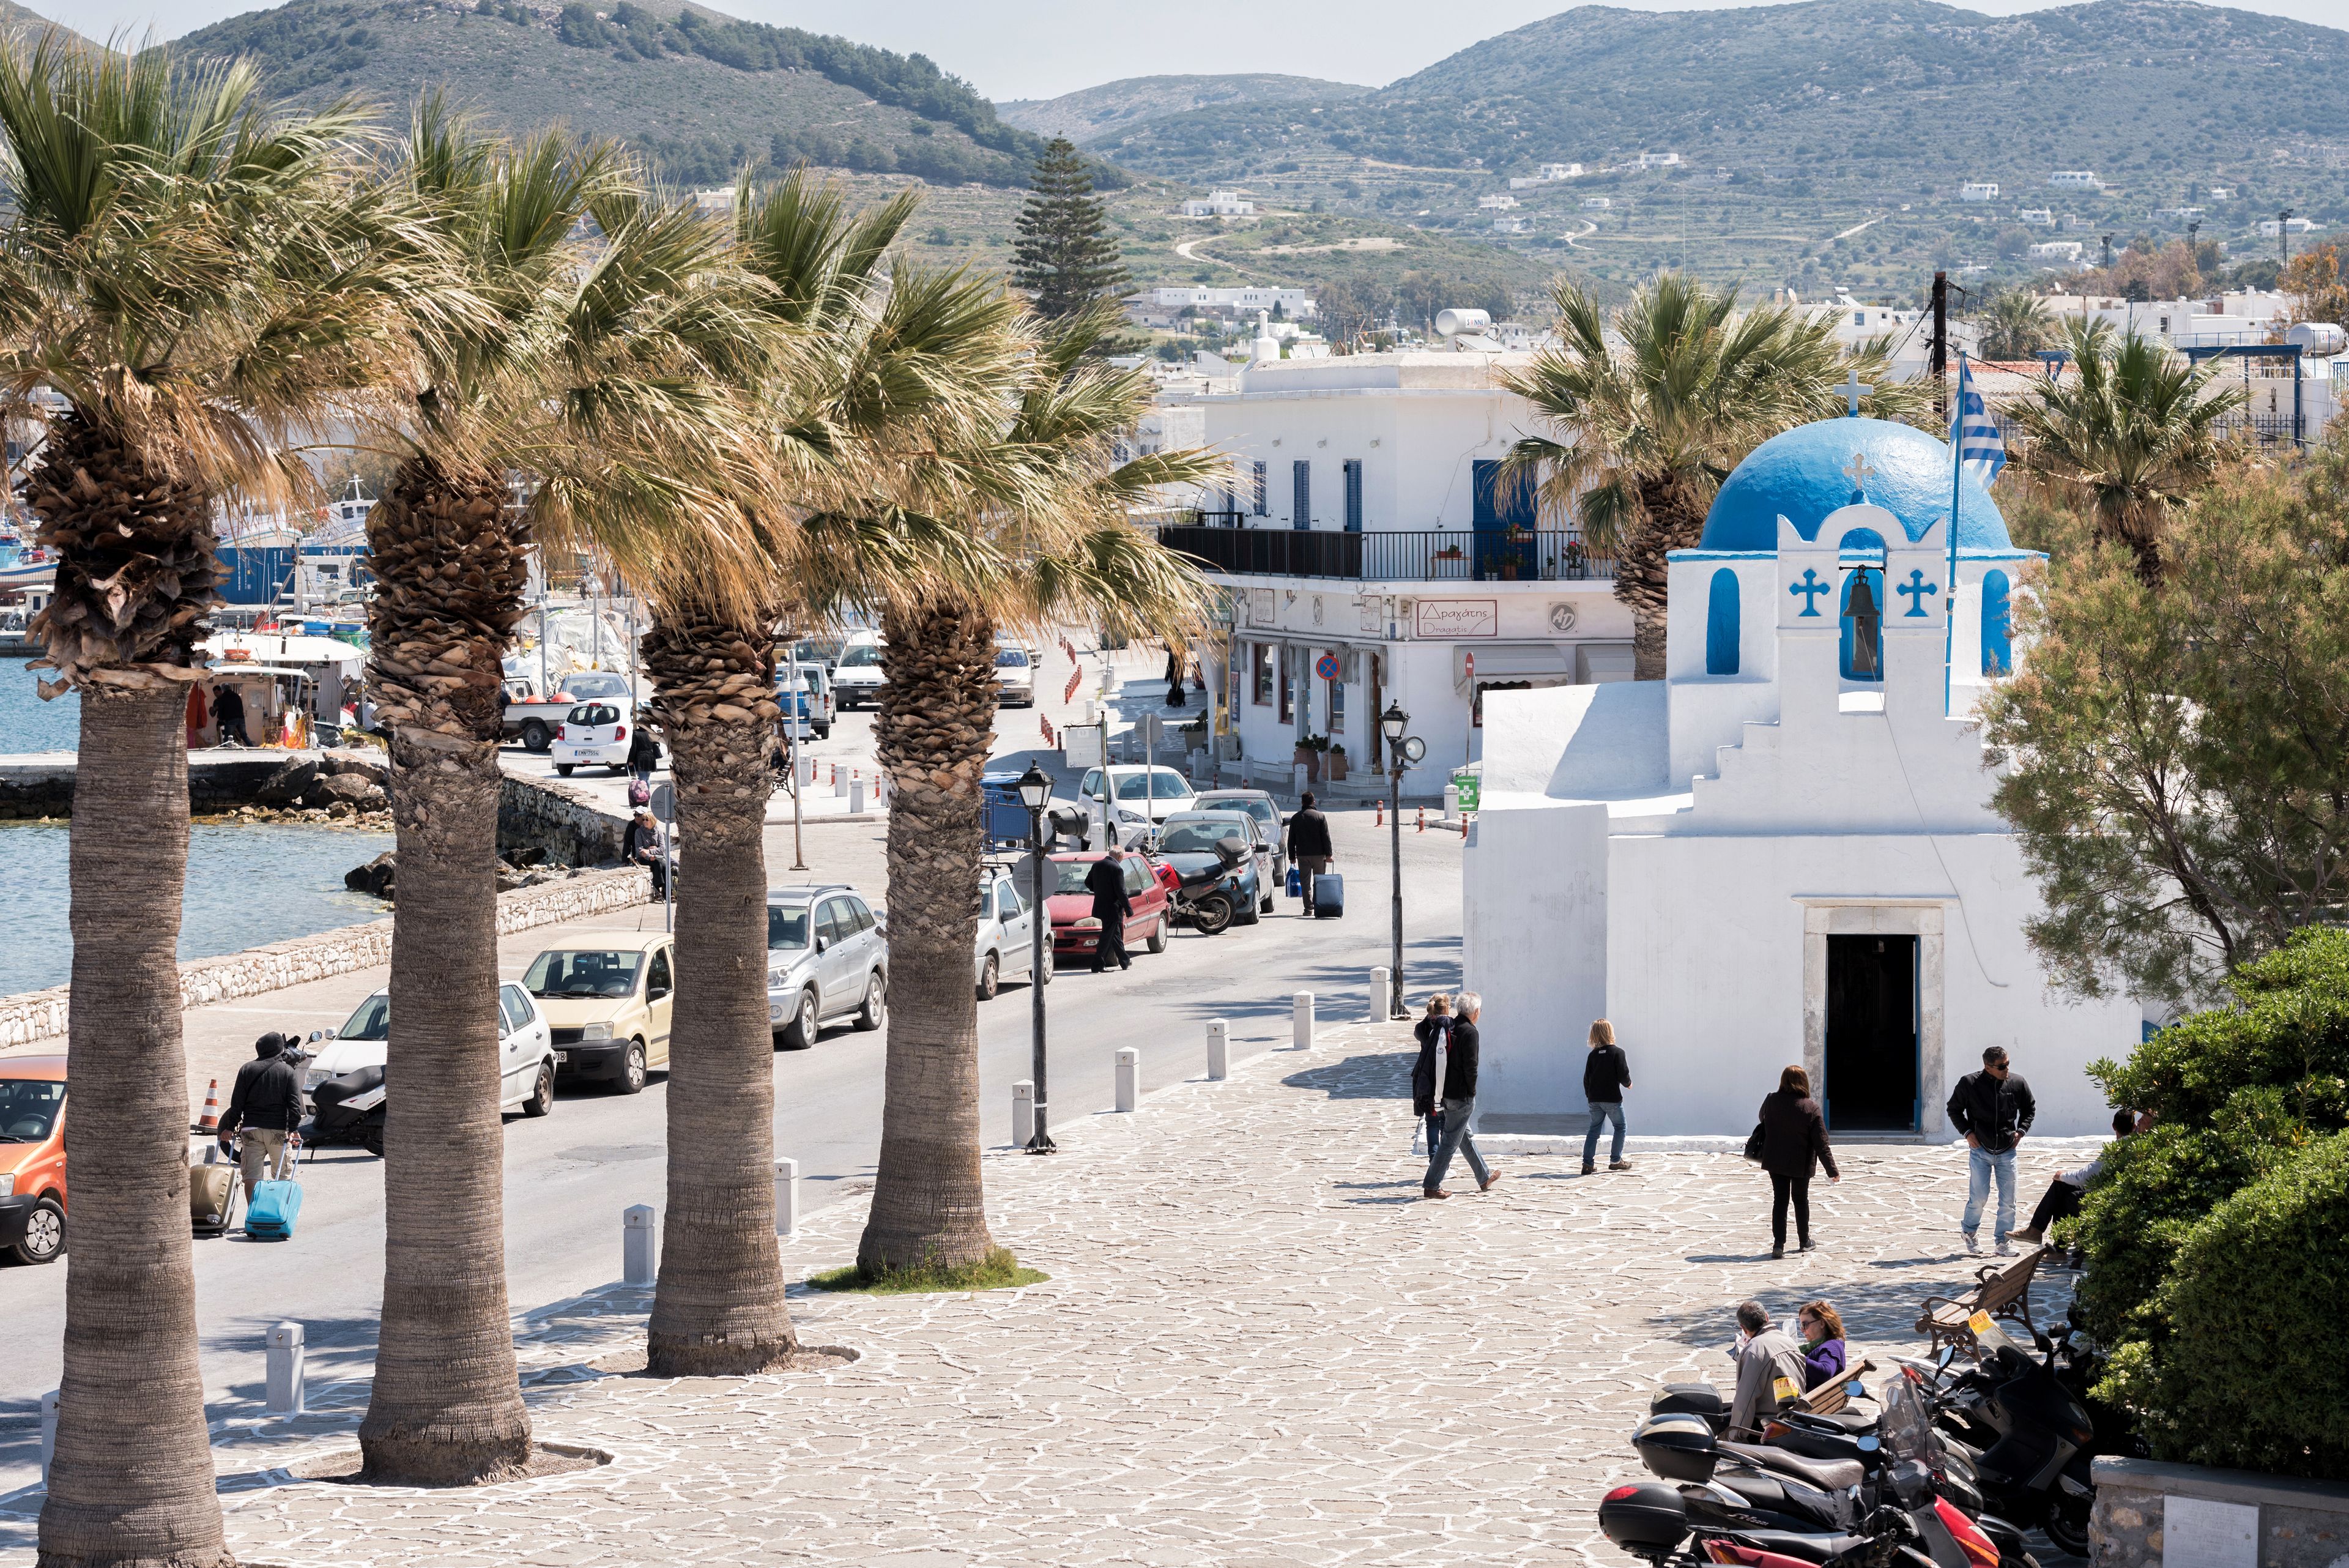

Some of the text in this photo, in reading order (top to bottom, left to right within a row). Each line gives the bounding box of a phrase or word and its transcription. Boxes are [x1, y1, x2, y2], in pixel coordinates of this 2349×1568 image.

[1421, 603, 1487, 621] Δραγάτης
[1553, 608, 1575, 629] AD
[1424, 622, 1467, 634] Dragatis
